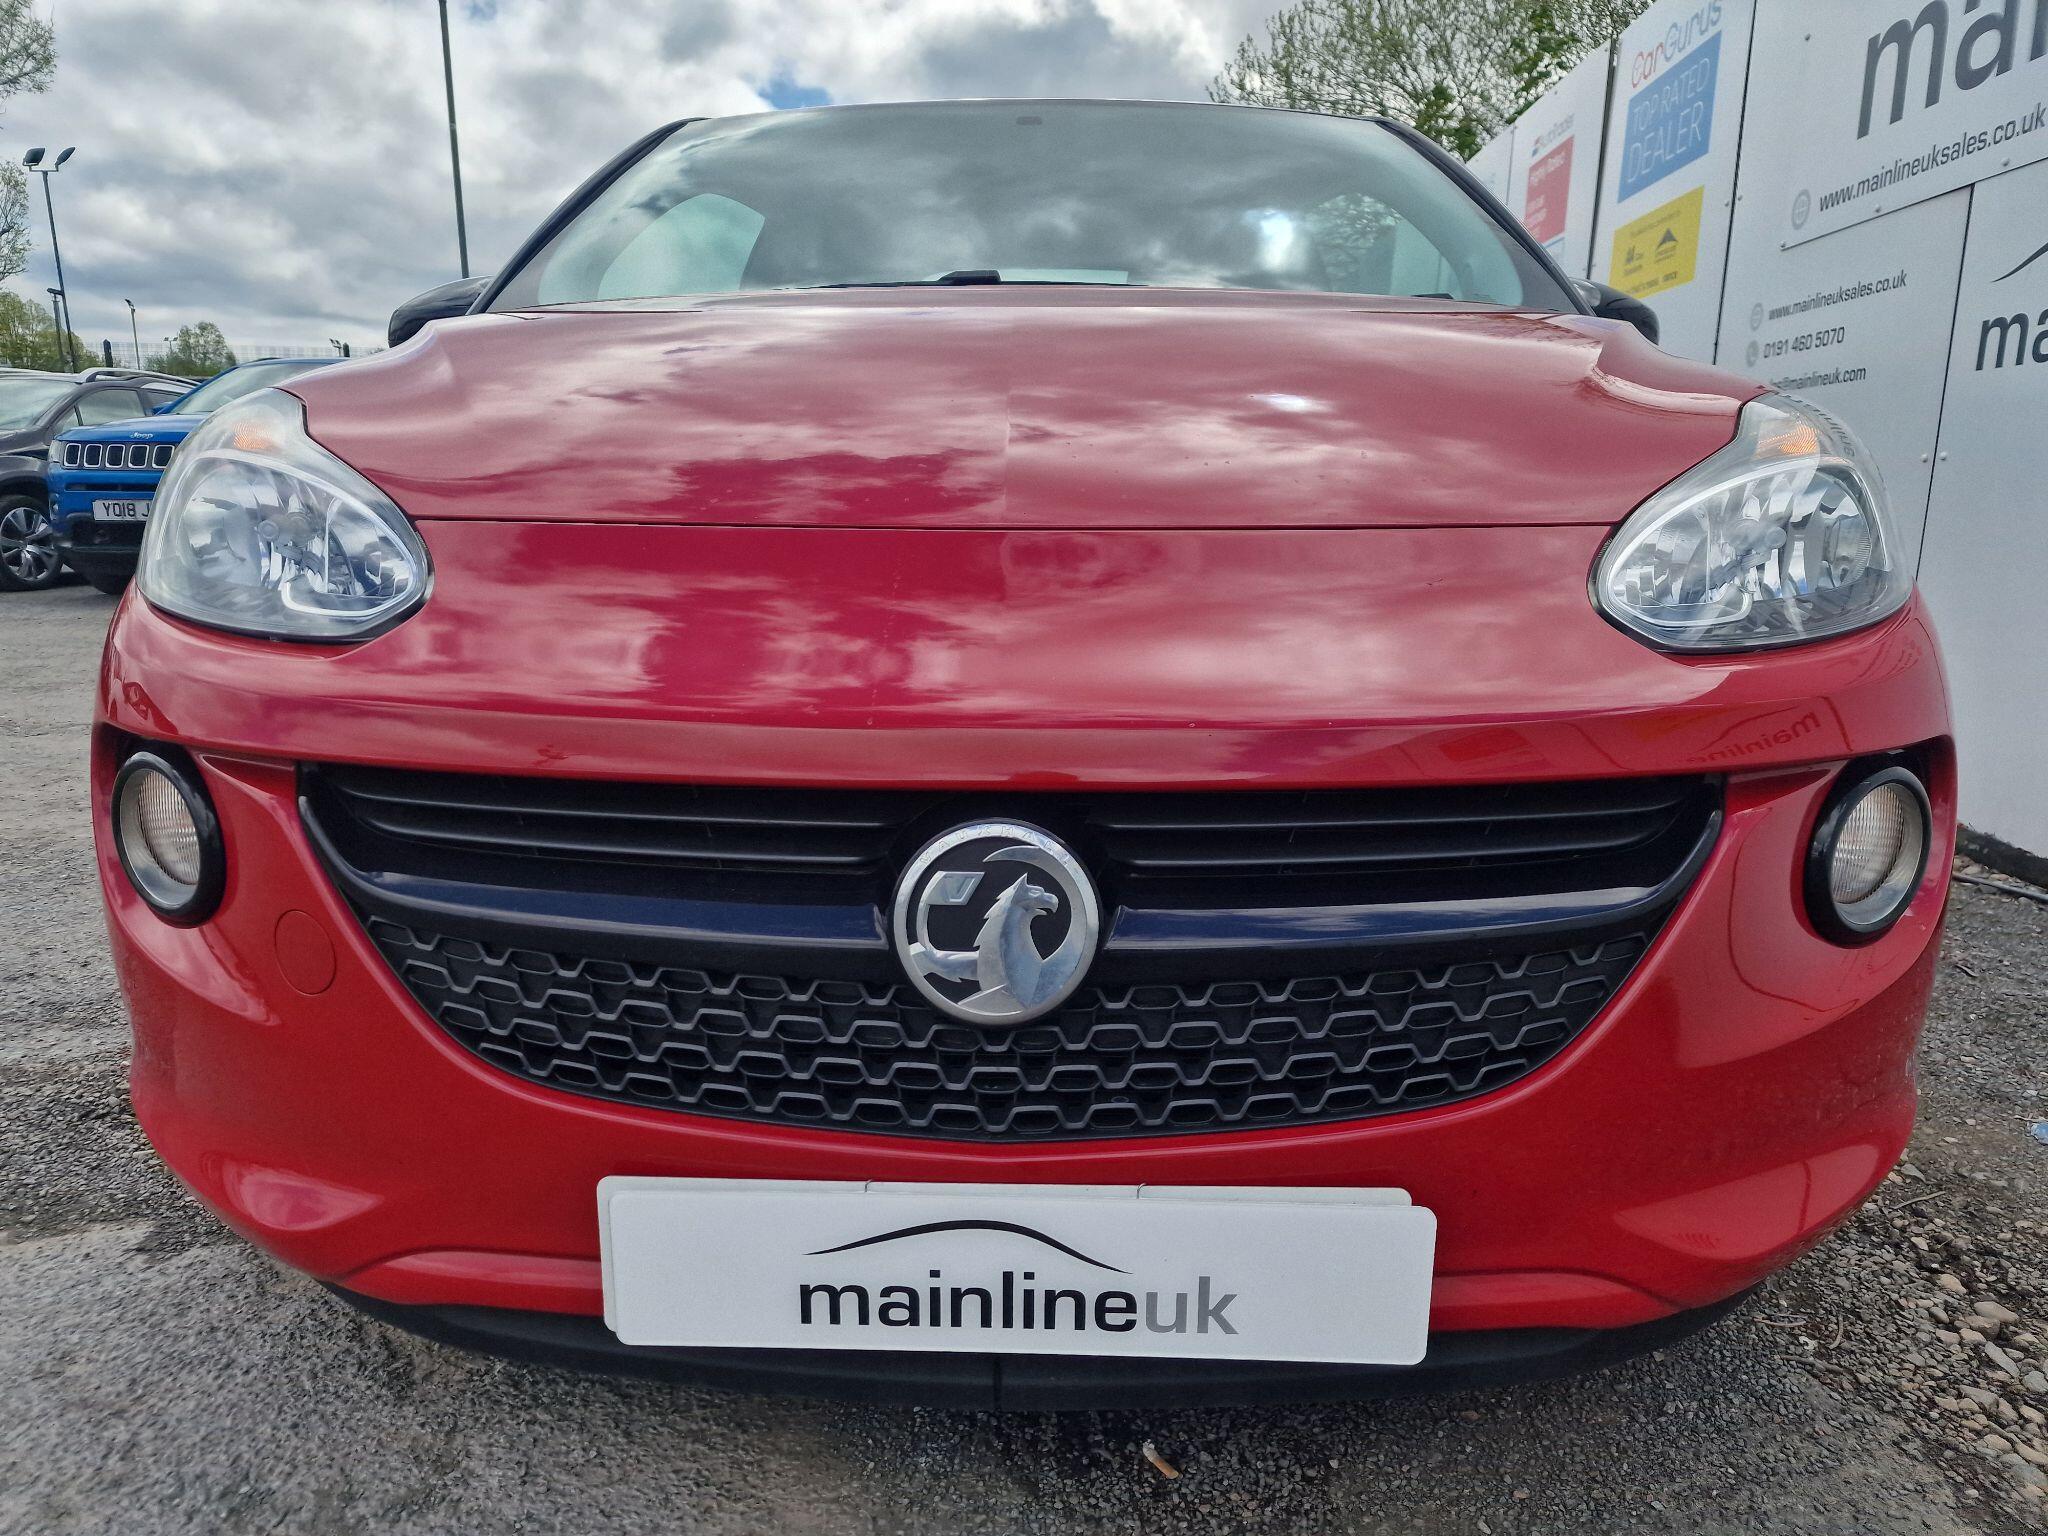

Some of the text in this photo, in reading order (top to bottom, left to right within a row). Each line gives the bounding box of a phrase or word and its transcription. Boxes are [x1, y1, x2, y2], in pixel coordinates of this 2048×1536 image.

[1632, 0, 1722, 88] CarGurus
[1633, 57, 1710, 136] TOP RATED
[1627, 101, 1704, 183] DEALER
[1819, 102, 2047, 212] www.mainlineuksales.co.uk
[1768, 269, 1907, 321] www.mainlineuksales.co.uk
[1763, 326, 1846, 359] 0191 460 5070
